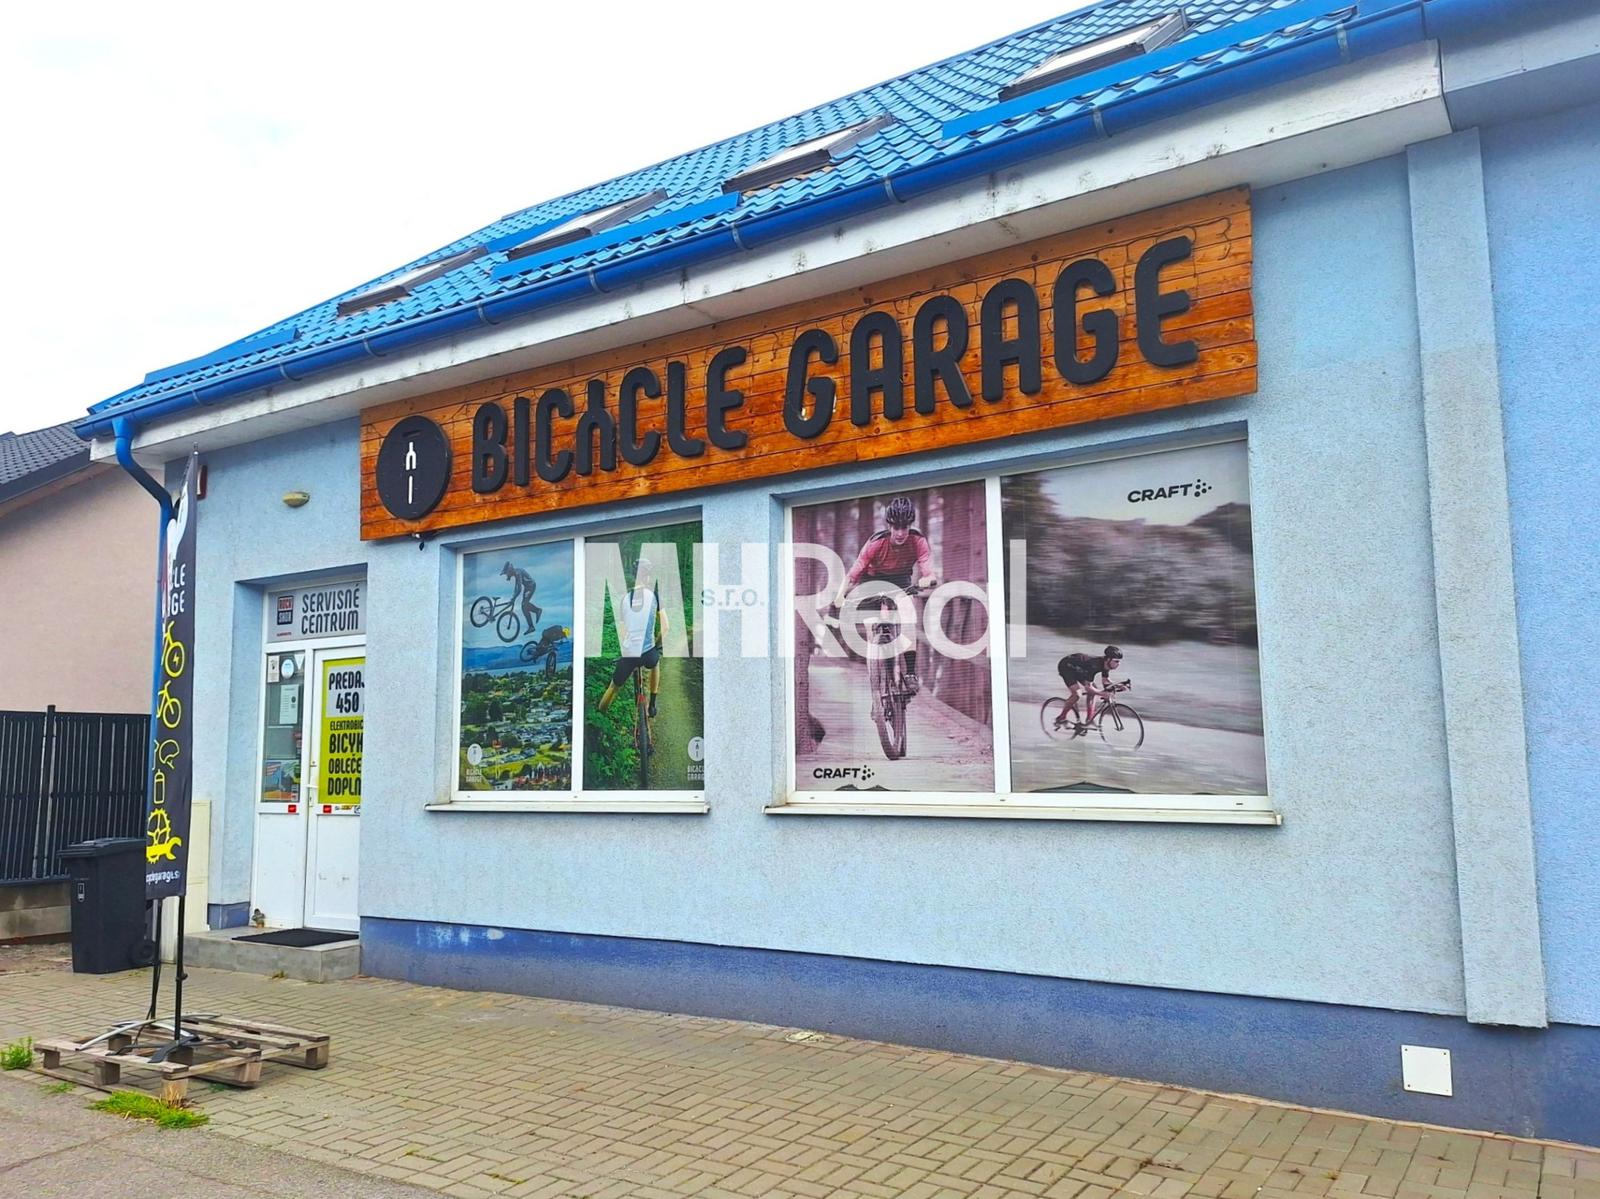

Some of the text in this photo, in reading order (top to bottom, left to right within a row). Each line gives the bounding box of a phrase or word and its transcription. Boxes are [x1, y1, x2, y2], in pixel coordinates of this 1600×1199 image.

[471, 235, 1199, 494] BICYCLE GARAGE
[1127, 483, 1193, 503] CRAFT
[302, 584, 360, 614] SERVISNÉ
[301, 610, 359, 635] CENTRUM
[336, 691, 360, 713] 450
[813, 767, 861, 779] CRAFT
